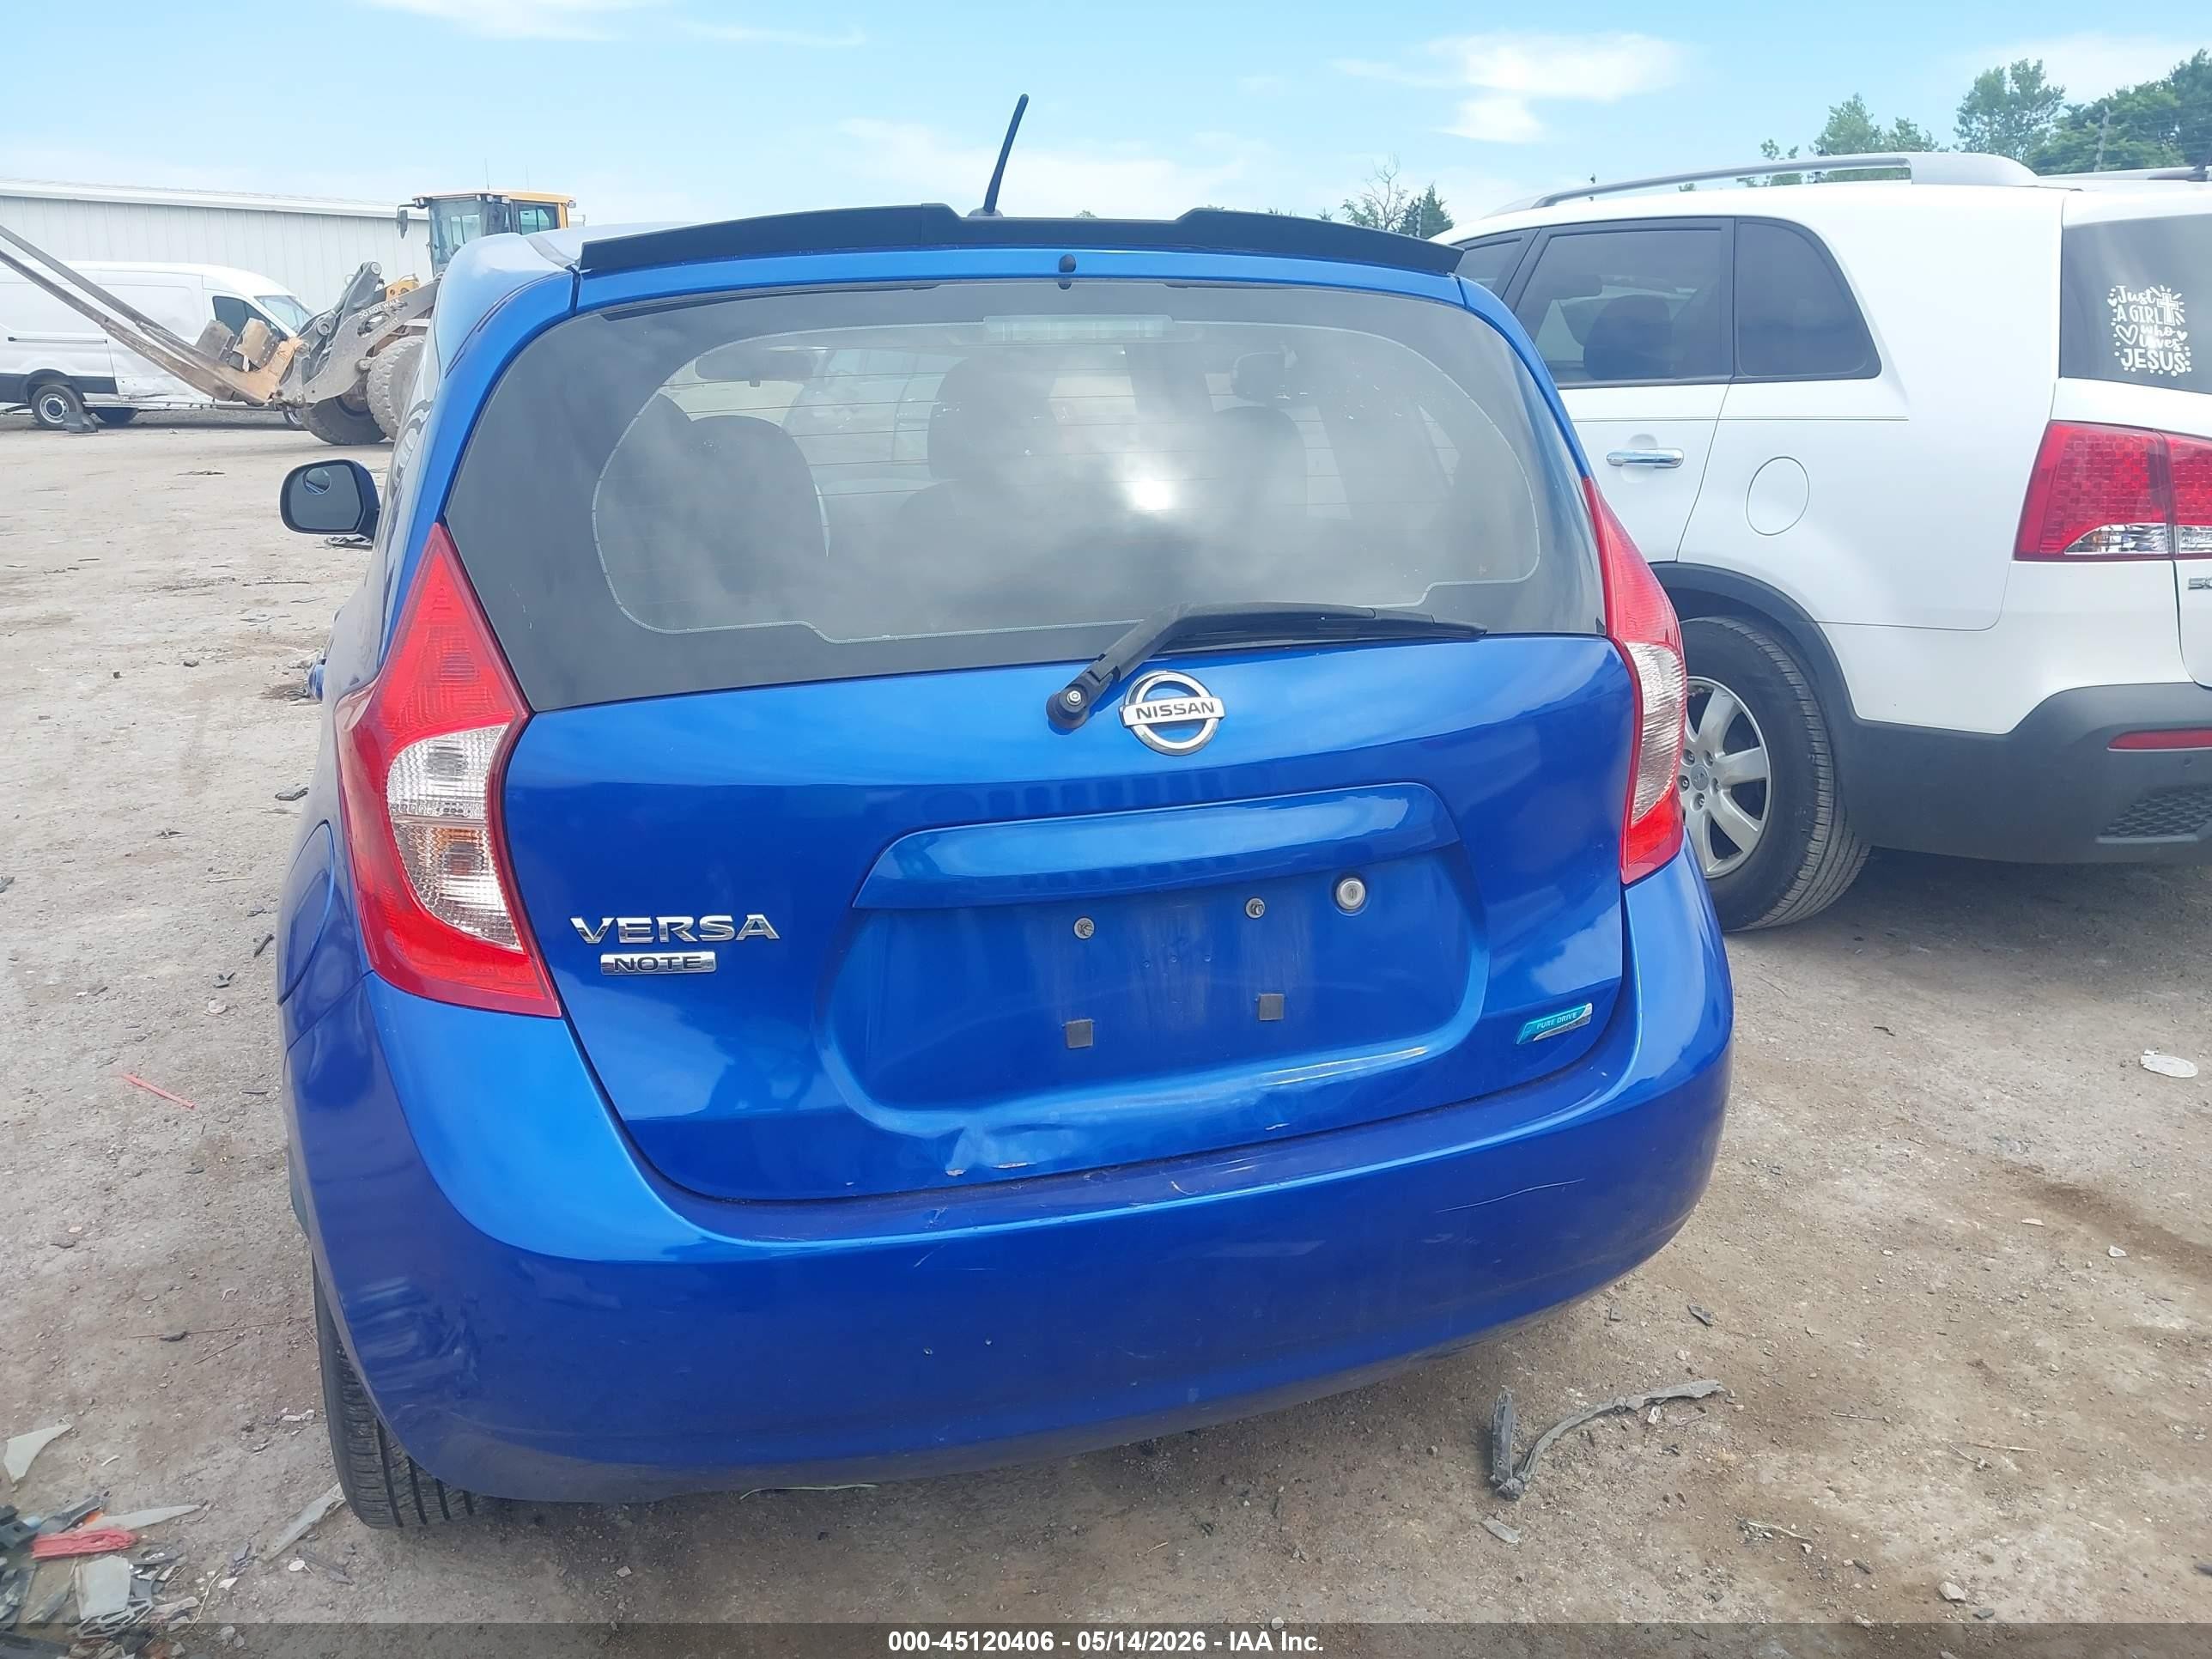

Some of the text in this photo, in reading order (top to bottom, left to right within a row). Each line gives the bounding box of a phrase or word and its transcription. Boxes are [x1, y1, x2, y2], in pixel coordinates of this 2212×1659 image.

[2115, 285, 2156, 305] Just
[369, 305, 381, 315] NOT
[2117, 305, 2163, 325] A GIRL
[2141, 325, 2176, 337] who
[2121, 348, 2186, 373] JESUS
[1136, 701, 1215, 720] NISSAN
[570, 914, 781, 944] VERSA
[614, 955, 702, 971] NOTE
[1537, 1012, 1577, 1029] PURE DRIVE
